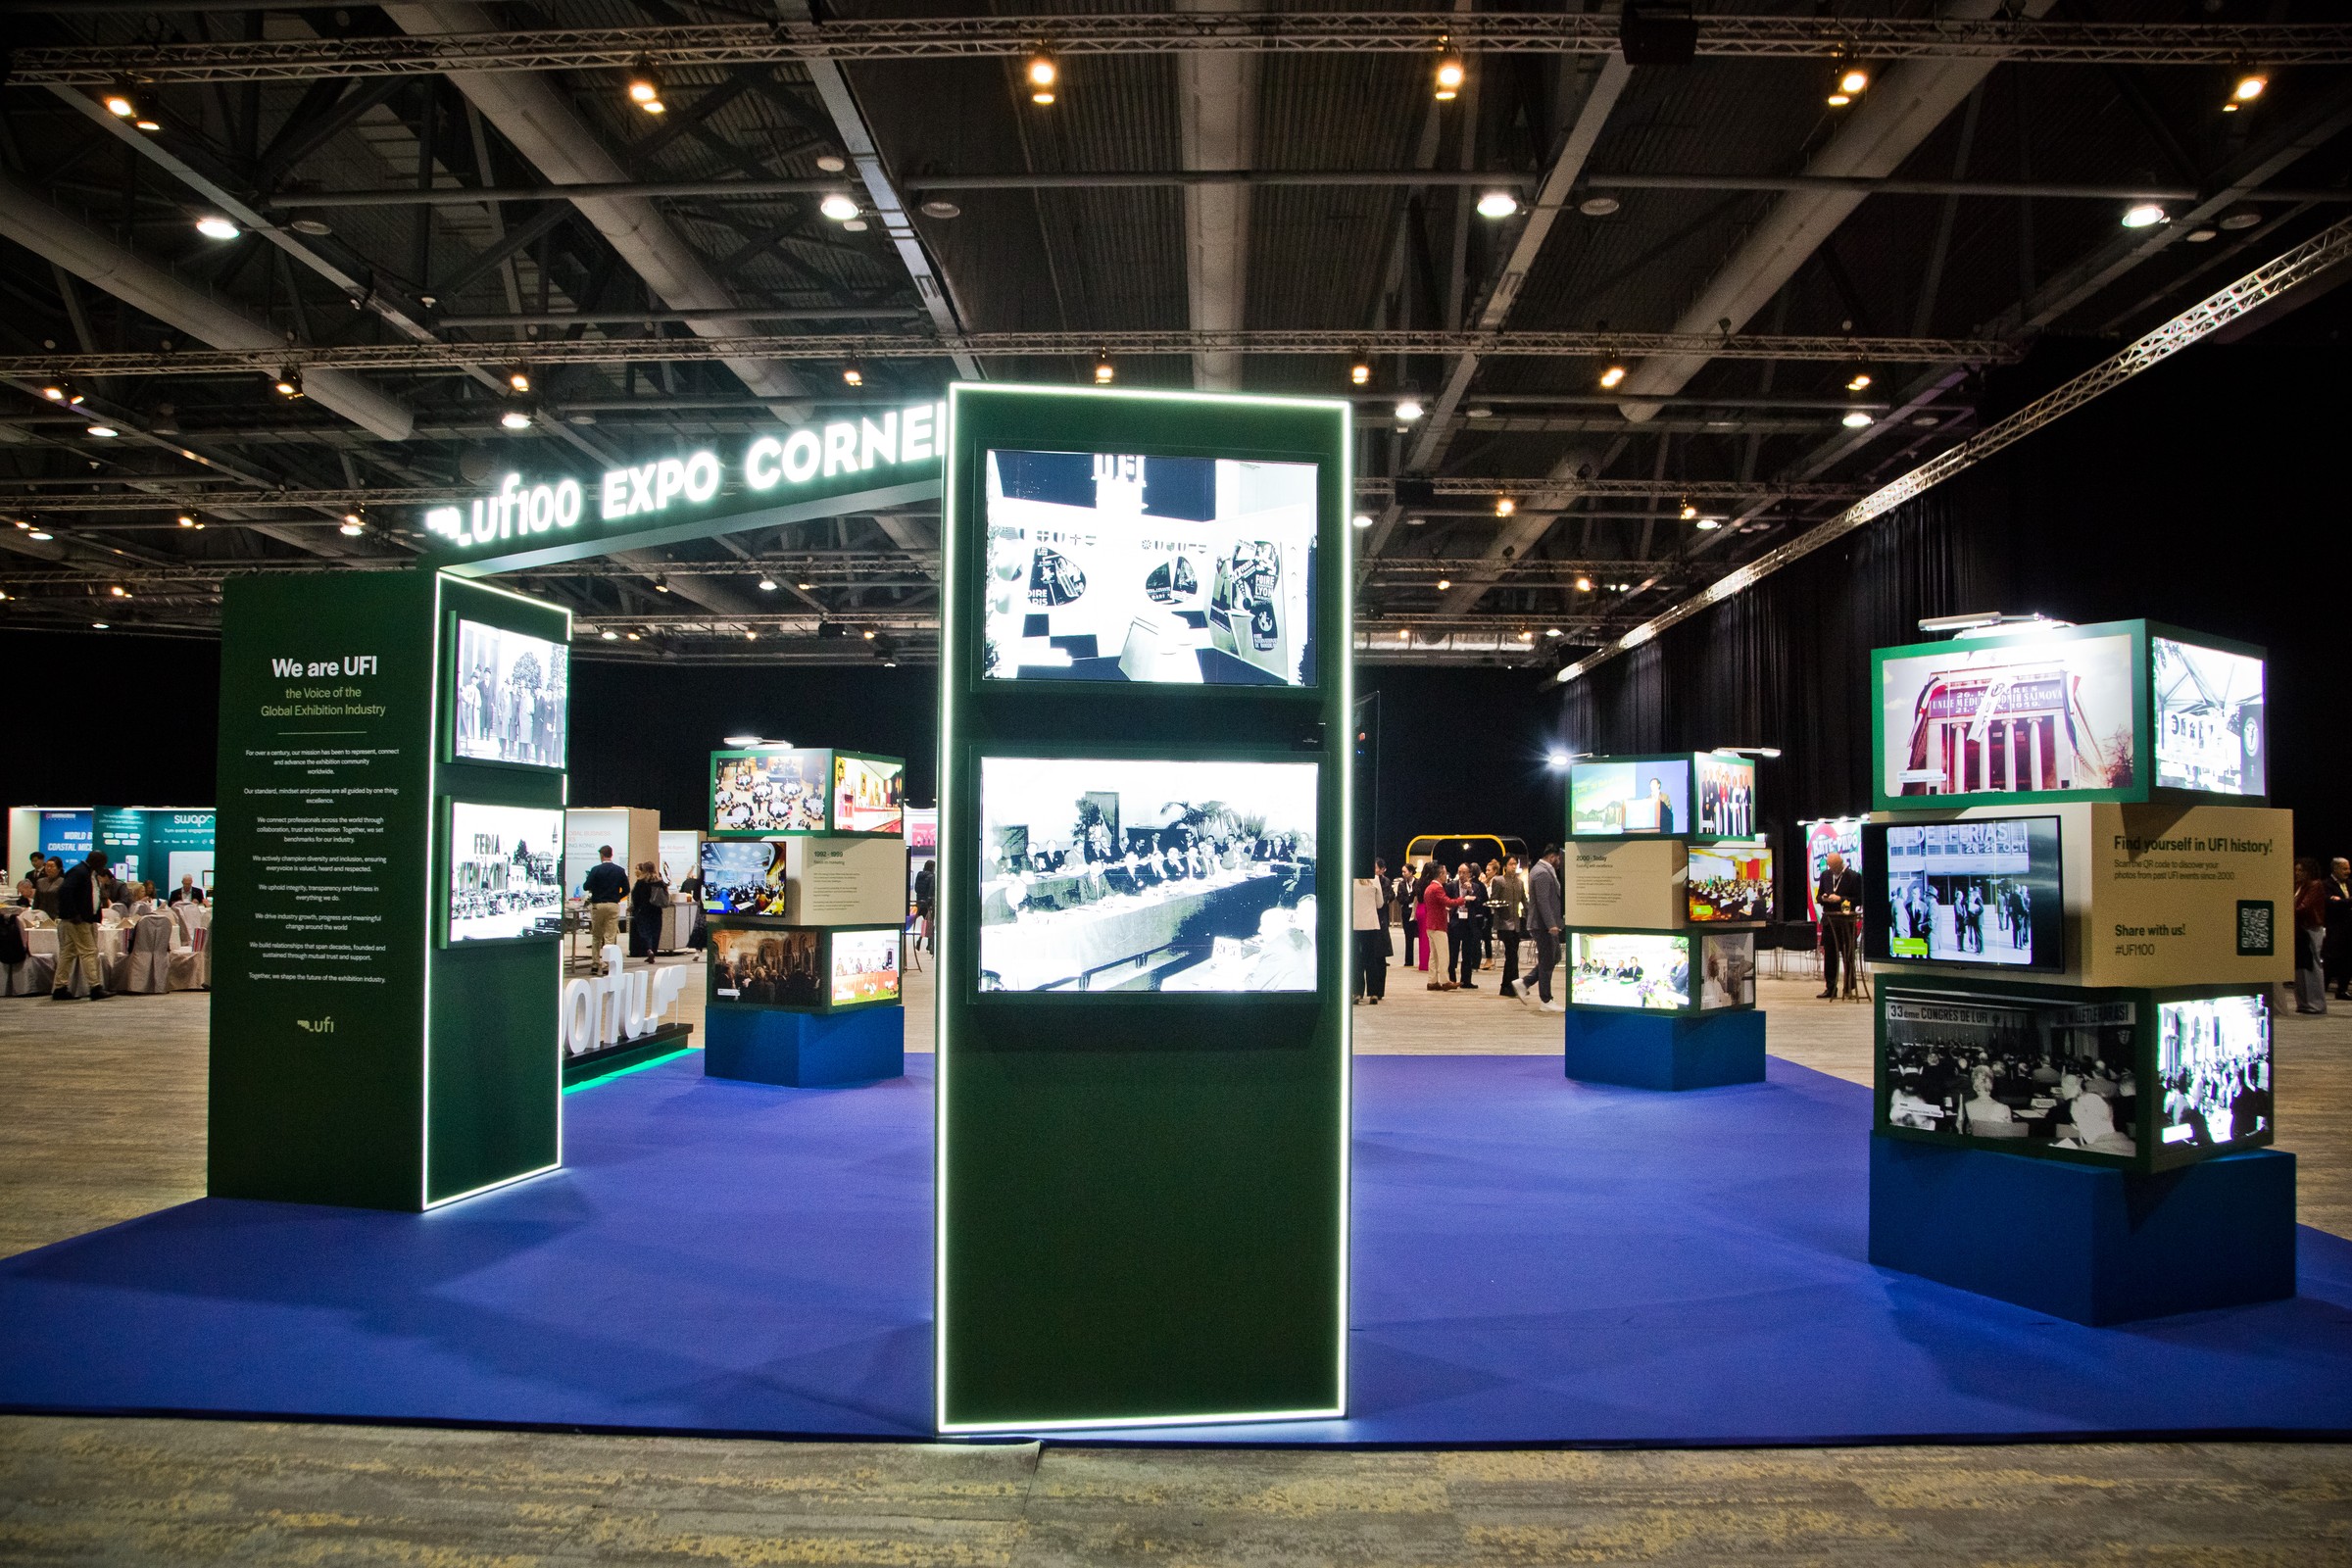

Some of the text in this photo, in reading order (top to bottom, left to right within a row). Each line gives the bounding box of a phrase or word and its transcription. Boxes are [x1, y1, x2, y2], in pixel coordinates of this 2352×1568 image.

[602, 452, 720, 519] EXPO
[271, 656, 377, 678] We are UFI
[285, 686, 362, 699] the Voice of the
[261, 704, 385, 717] Global Exhibition Industry
[474, 833, 500, 855] FERIA
[2114, 836, 2273, 856] Find yourself in UFI history!
[2143, 859, 2153, 869] QR
[2114, 871, 2136, 880] photos
[2137, 870, 2152, 879] from
[2153, 871, 2167, 880] past
[2180, 871, 2199, 880] events
[2115, 923, 2186, 937] Share with us!
[2115, 944, 2155, 956] #UFI100
